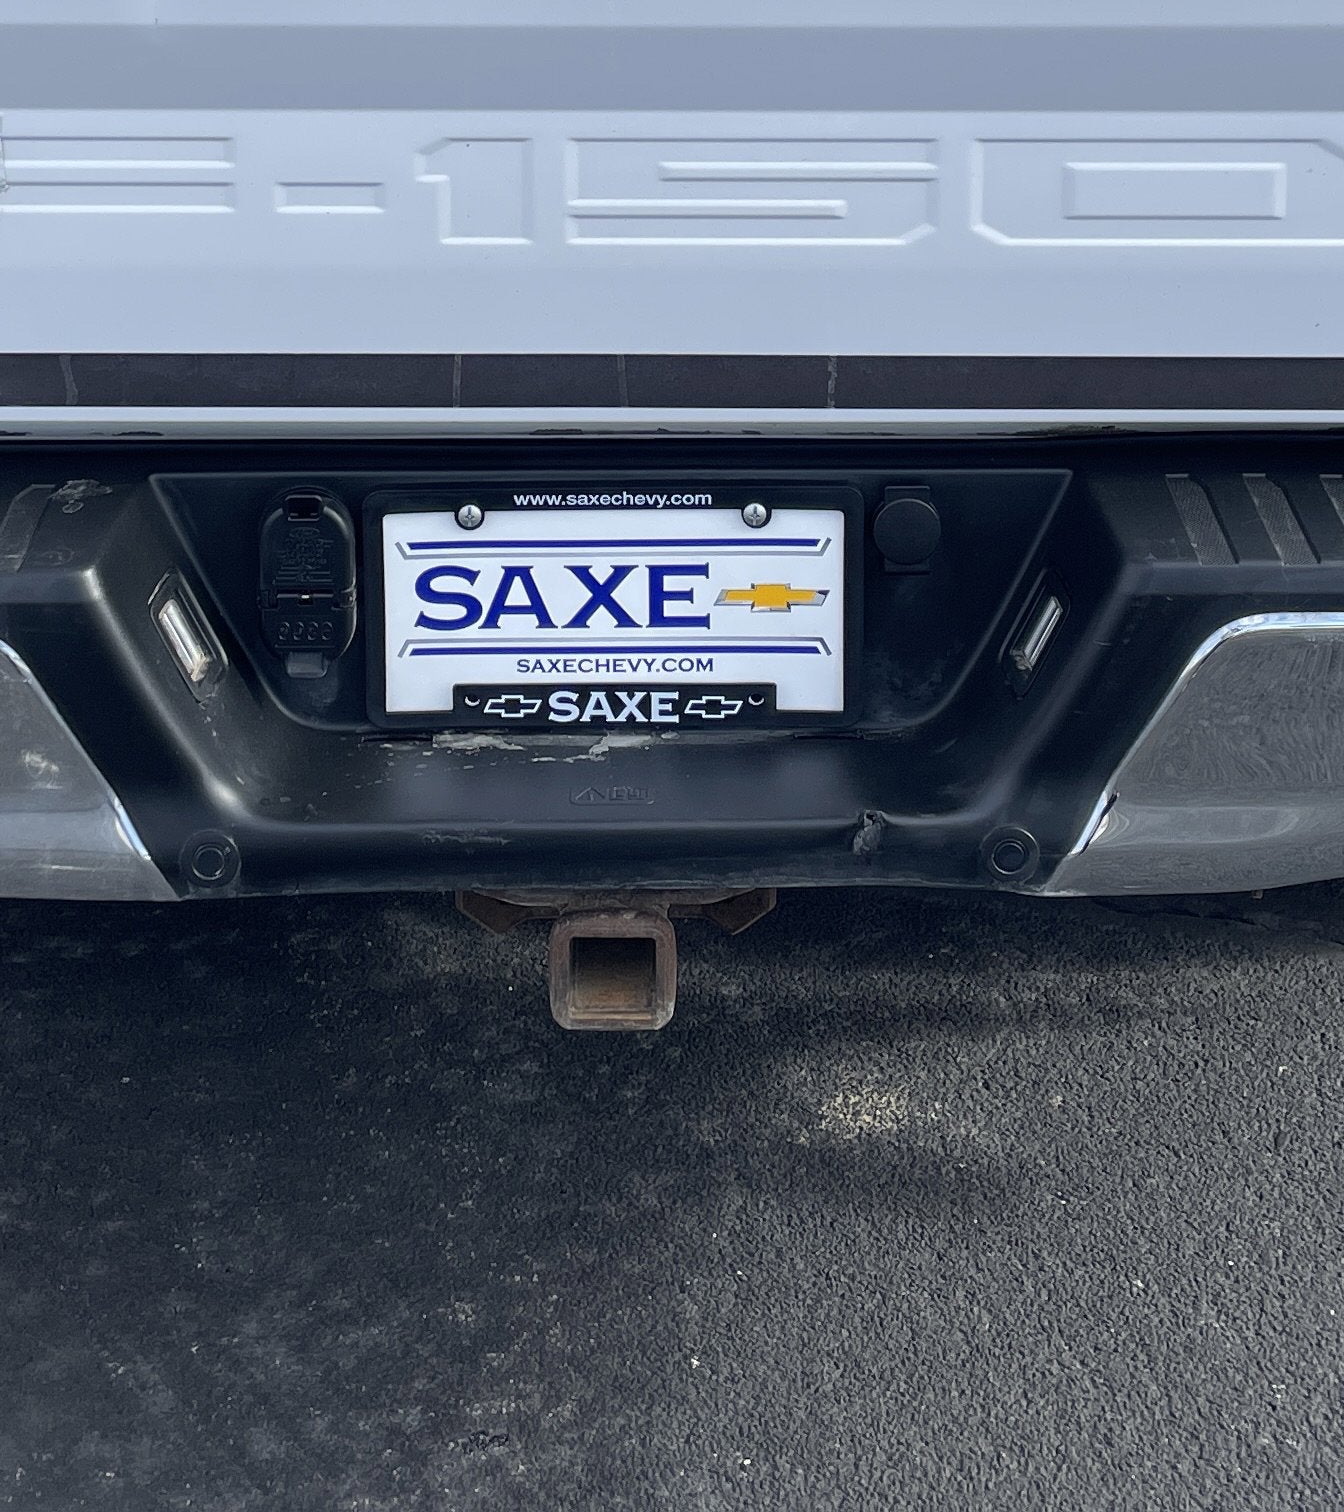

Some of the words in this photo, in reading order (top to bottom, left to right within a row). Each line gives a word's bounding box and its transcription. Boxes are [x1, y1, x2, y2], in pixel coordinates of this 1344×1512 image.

[513, 490, 713, 508] www.saxechevy.com
[413, 561, 711, 631] SAXE
[516, 657, 714, 673] SAXECHEVY.COM
[546, 690, 680, 723] SAXE
